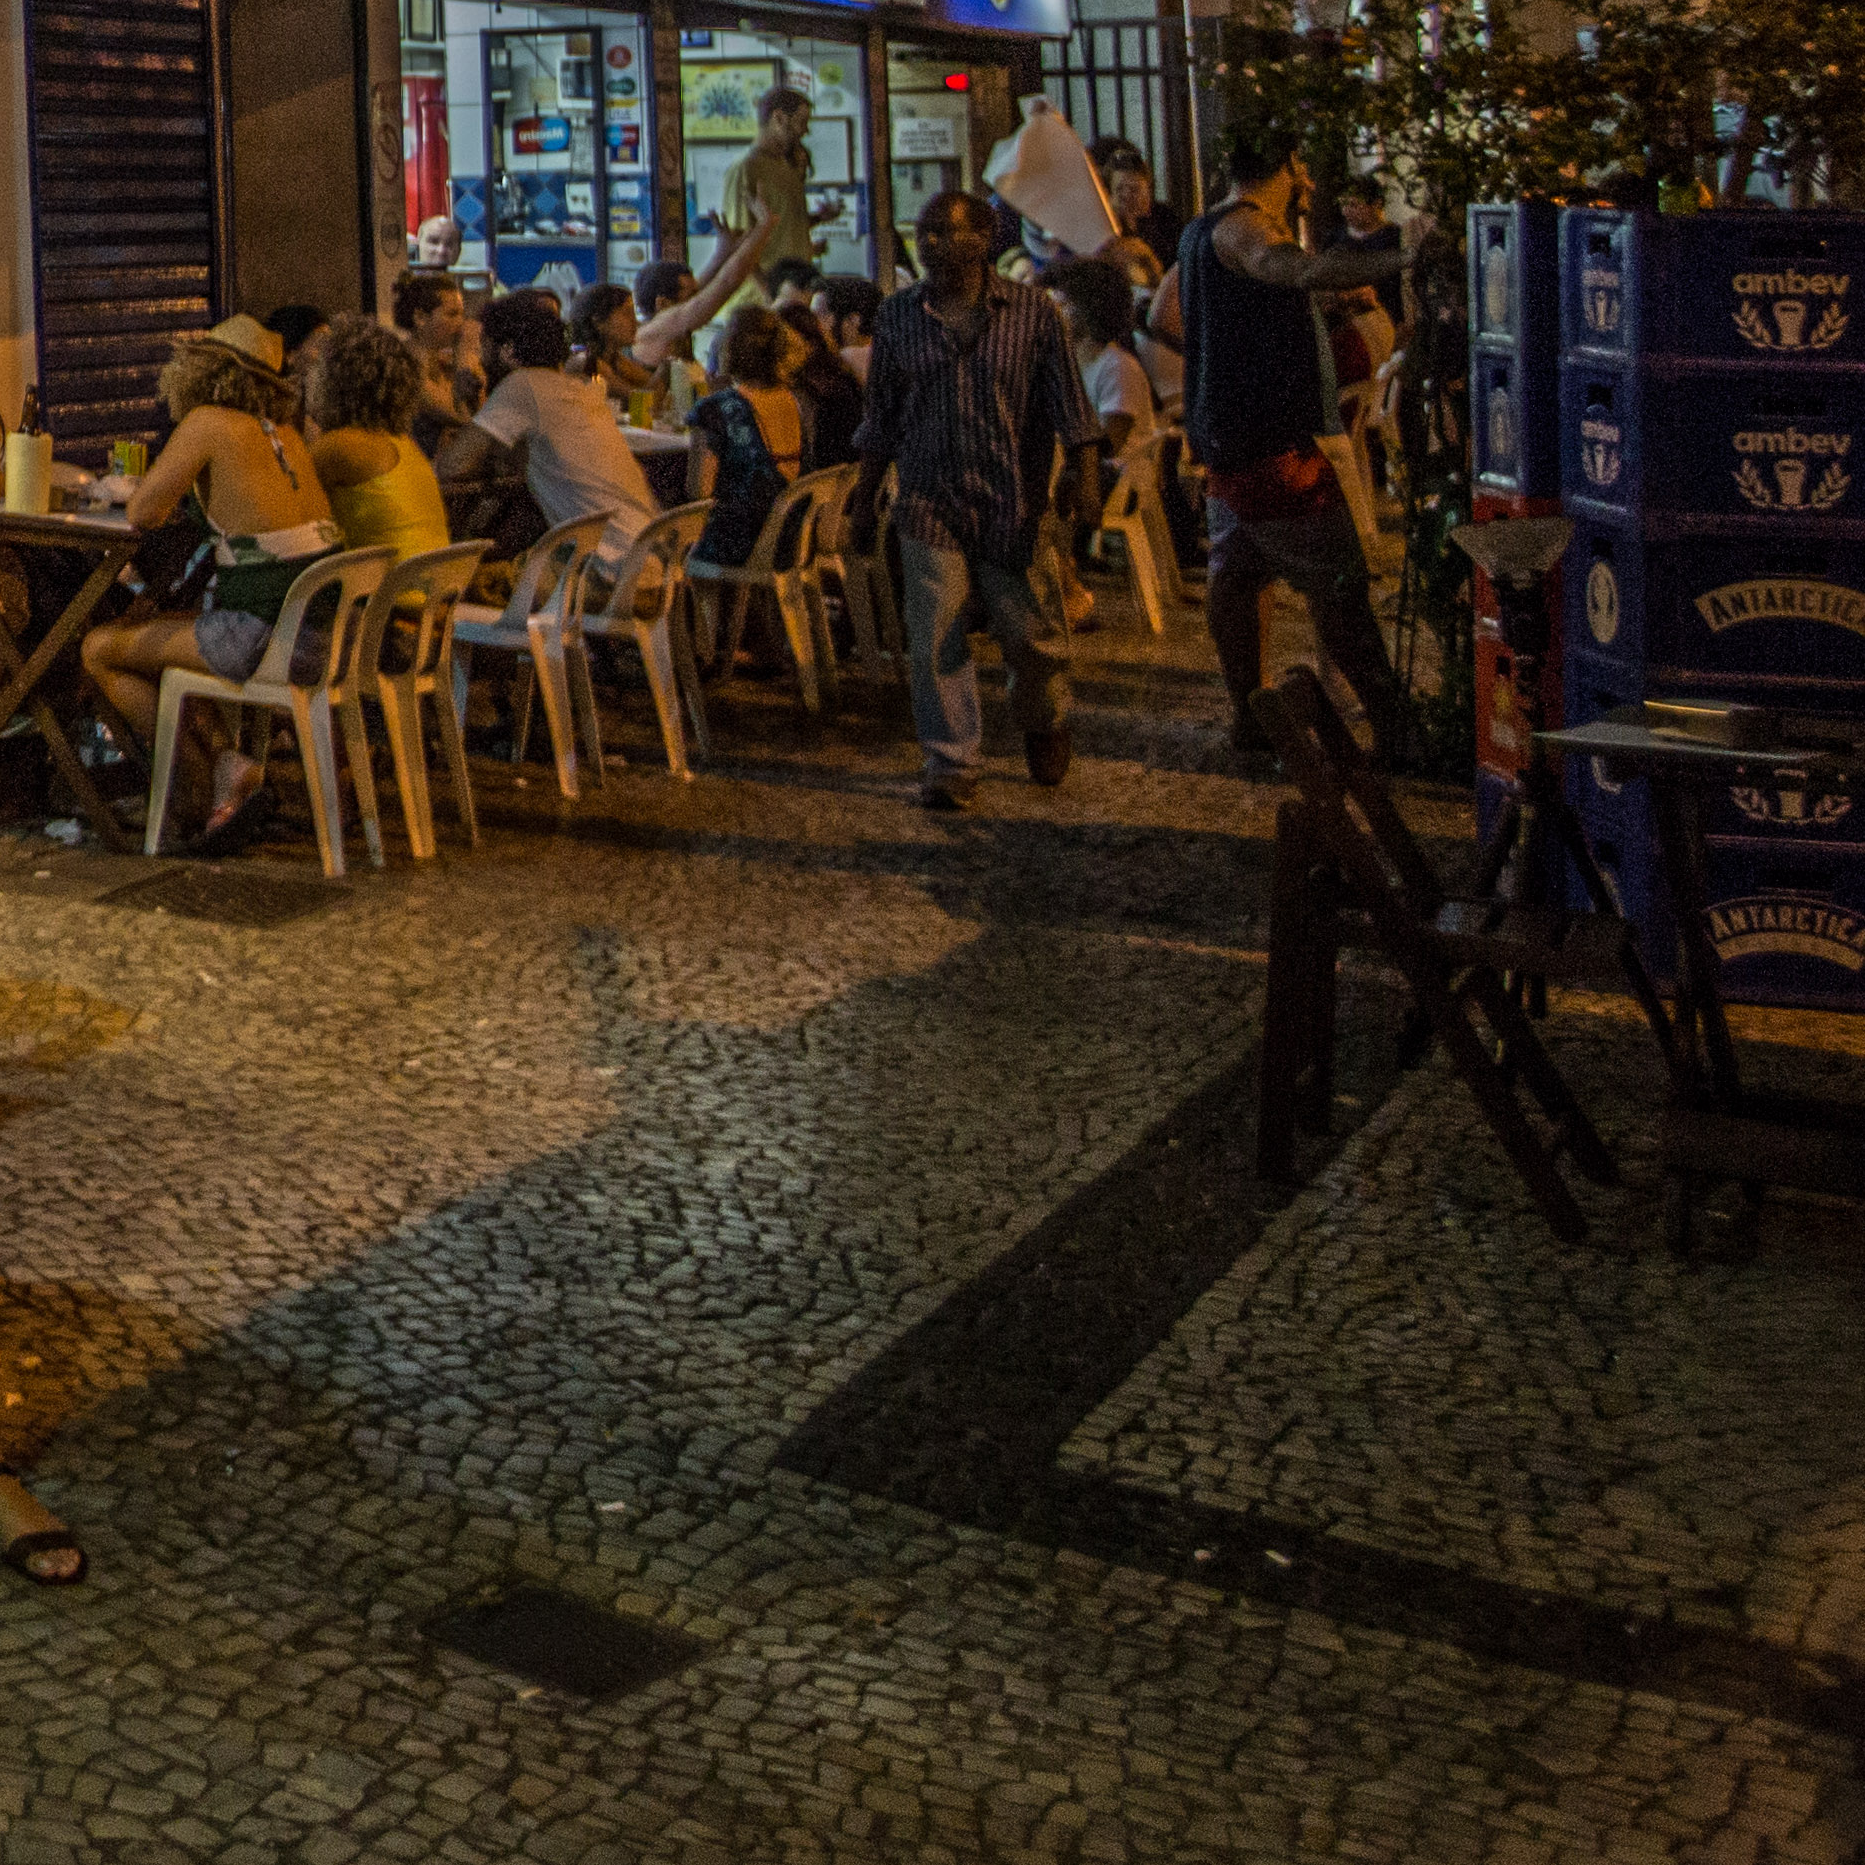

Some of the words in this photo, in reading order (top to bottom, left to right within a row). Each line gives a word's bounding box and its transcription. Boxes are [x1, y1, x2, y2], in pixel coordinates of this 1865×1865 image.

[1732, 269, 1851, 296] ambev
[1732, 427, 1852, 456] ambev
[1710, 589, 1865, 623] ANTARCTIC
